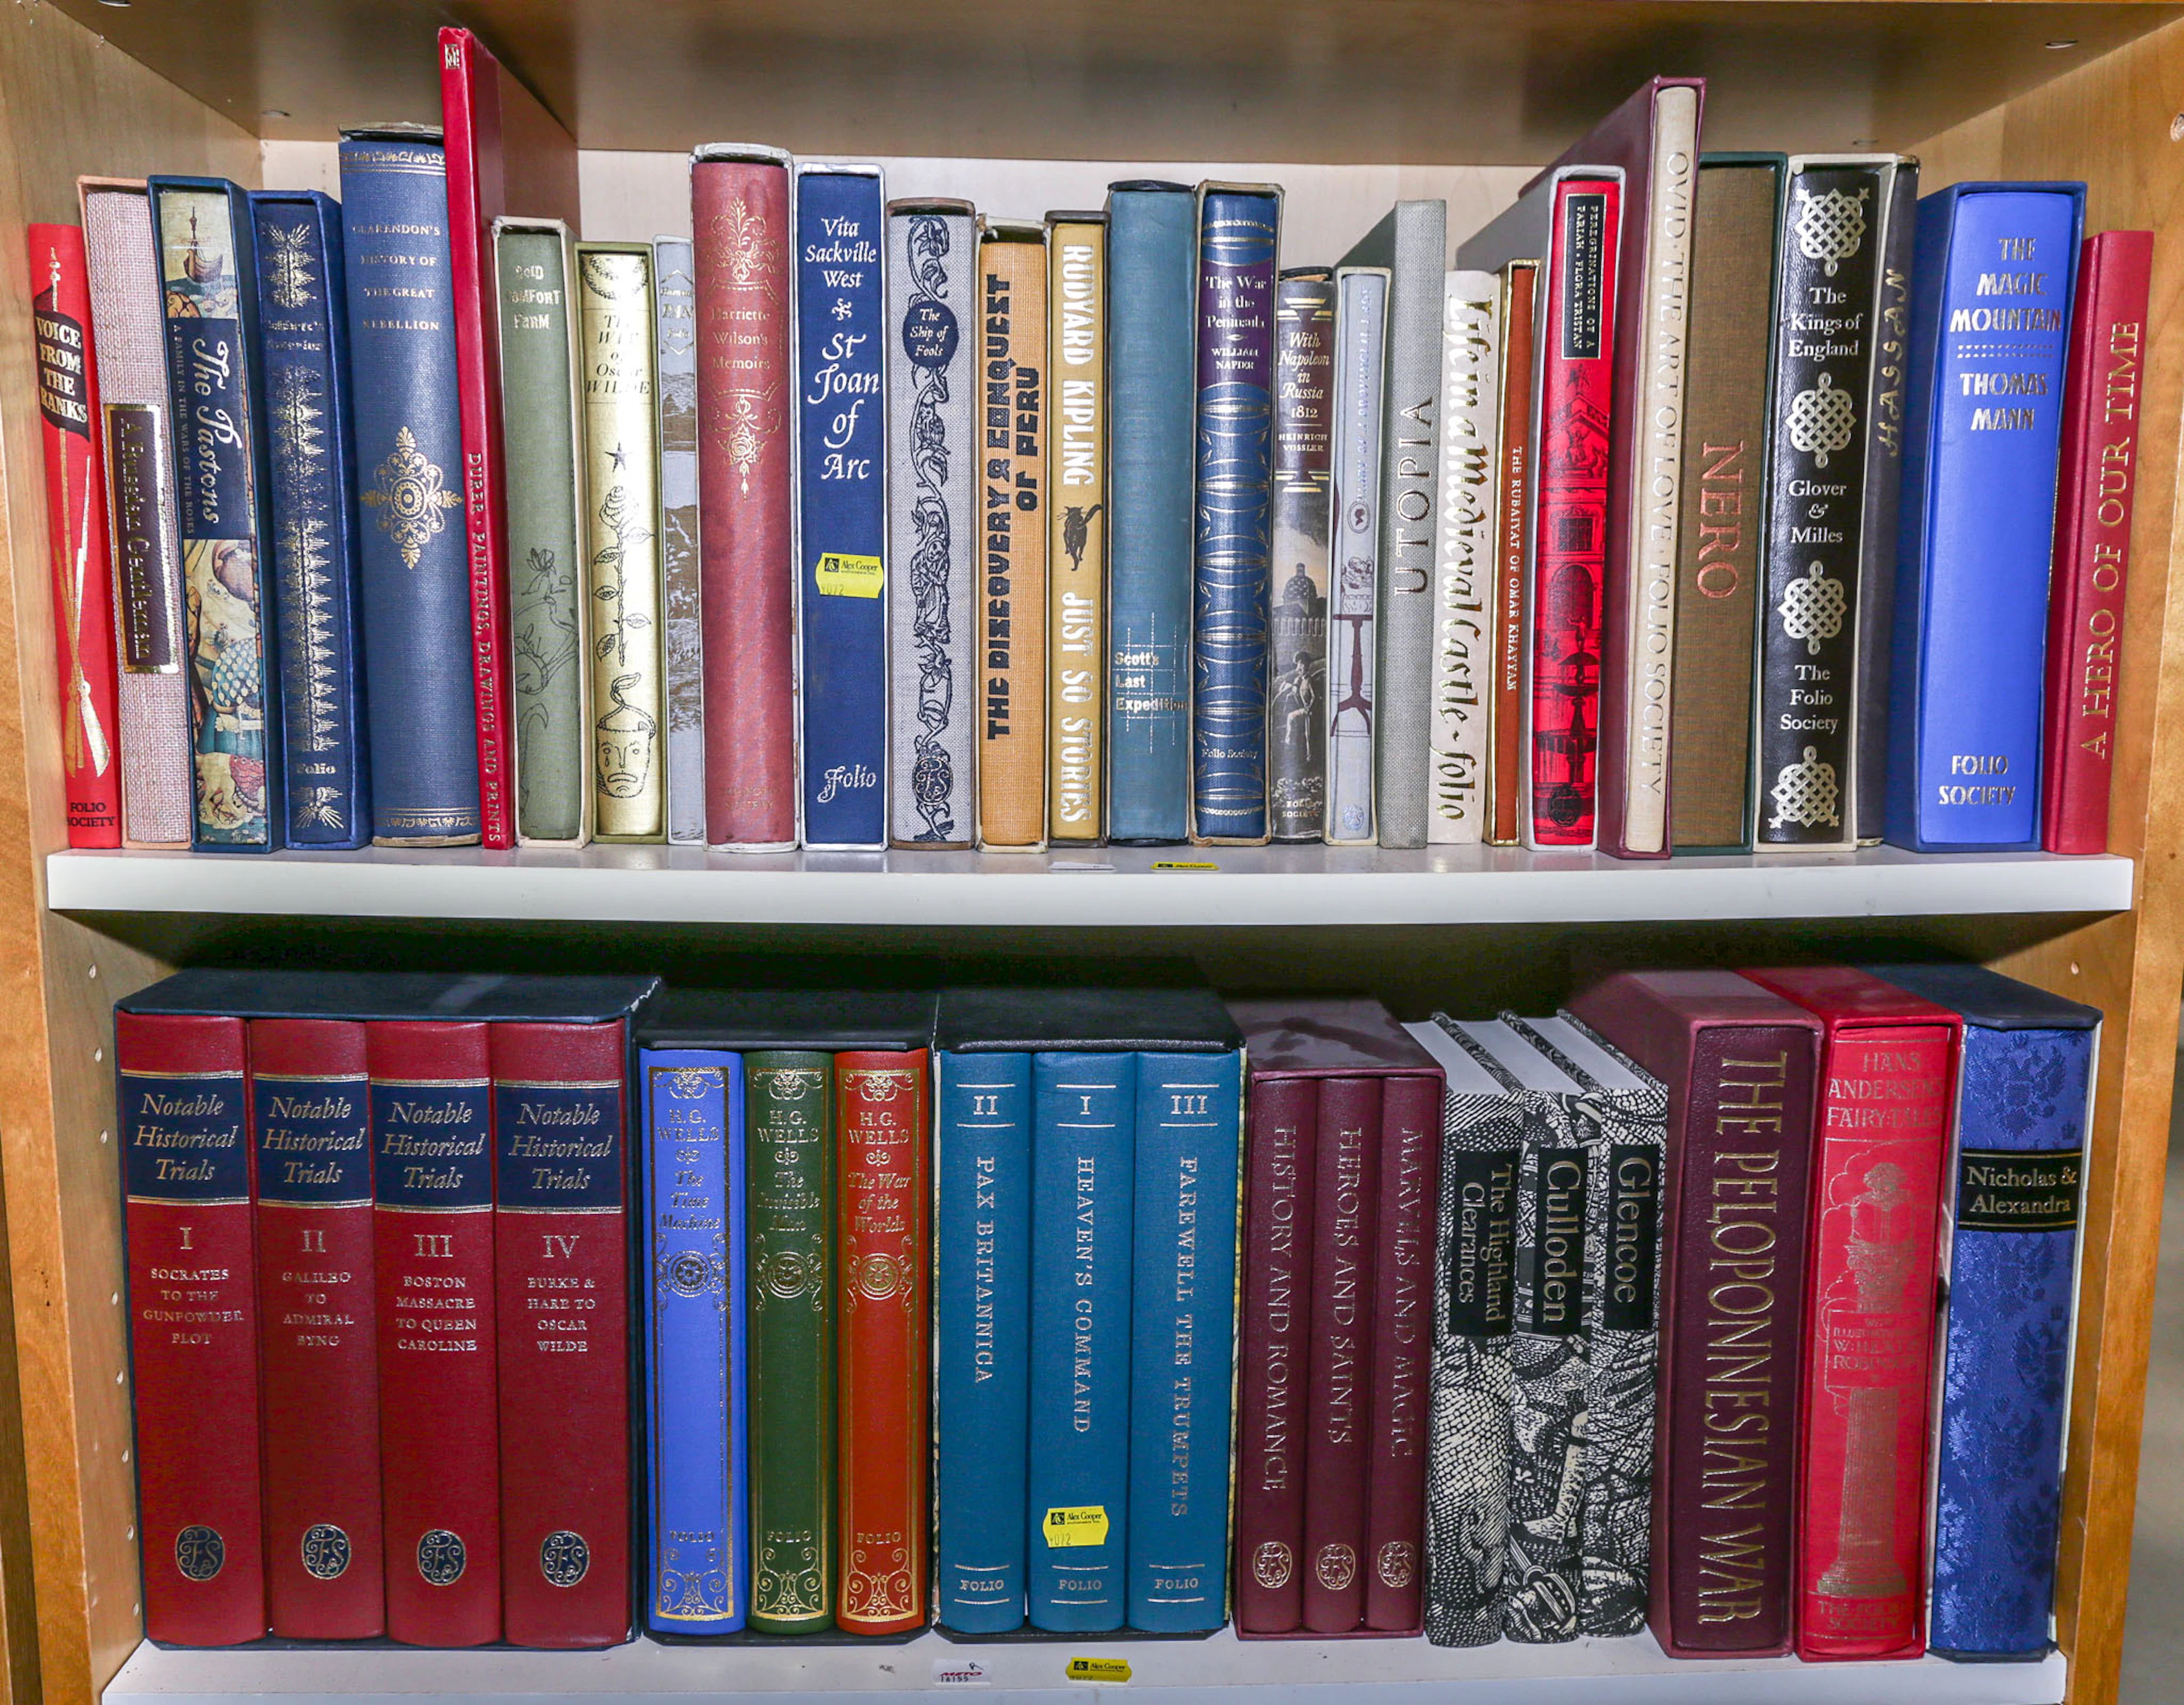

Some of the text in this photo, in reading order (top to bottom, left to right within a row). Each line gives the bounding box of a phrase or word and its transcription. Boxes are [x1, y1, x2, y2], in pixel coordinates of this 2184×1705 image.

[821, 216, 860, 237] Vita
[805, 241, 877, 263] Sackville
[1999, 238, 2036, 261] THE
[822, 270, 863, 288] West
[1575, 260, 1584, 298] FLORA
[1976, 273, 2048, 296] MAGIC
[1809, 287, 1847, 304] The
[920, 308, 940, 321] The
[1790, 313, 1864, 335] Kings of
[1950, 308, 2062, 332] MOUNTAIN
[35, 316, 81, 349] VOICE
[910, 326, 949, 342] Ship of
[1573, 303, 1583, 349] TRISTAN
[1586, 319, 1595, 333] OF
[822, 333, 867, 361] St
[915, 343, 944, 357] Fools
[1289, 332, 1321, 348] With
[39, 343, 81, 374] FROM
[1278, 350, 1330, 373] Napoleon
[1788, 341, 1859, 361] England
[1062, 245, 1095, 487] RUDYARD KIPLING
[1297, 369, 1311, 383] in
[43, 368, 75, 395] THE
[808, 363, 880, 404] Joan
[1279, 383, 1324, 400] Russia
[1960, 373, 2048, 395] THOMAS
[40, 386, 88, 423] RANKS
[1290, 405, 1319, 418] 1812
[824, 399, 864, 449] of
[1970, 408, 2034, 431] MANN
[191, 337, 242, 525] The Pastons
[1016, 367, 1040, 511] OF PERU
[1279, 433, 1328, 441] HEINRICH
[821, 455, 870, 481] Arc
[1641, 151, 1689, 794] OVID THE ART OF LOVE FOLIO SOCIETY
[1395, 397, 1433, 596] UTOPIA
[1788, 480, 1847, 497] Glover
[986, 274, 1017, 740] THE DISCOVERY & CONQUEST
[1809, 505, 1828, 520] &
[1697, 440, 1744, 600] NERO
[1790, 527, 1843, 544] Milles
[2080, 321, 2140, 759] A HERO OF OUR TIME
[842, 560, 879, 571] Alex Cooper
[1507, 445, 1523, 691] THE RUBAIYAT OF OMAR KHAYYAM
[1115, 651, 1160, 667] Scott's
[1115, 674, 1146, 689] Last
[1795, 664, 1830, 681] The
[1060, 592, 1094, 823] JUST SO STORIES
[1115, 696, 1187, 713] Expedition
[1789, 690, 1833, 706] Folio
[1780, 715, 1839, 735] Society
[1951, 755, 2008, 775] FOLIO
[817, 763, 876, 803] Folio
[1938, 786, 2016, 805] SOCIETY
[140, 1093, 223, 1116] Notable
[516, 1103, 600, 1125] Notable
[973, 1095, 998, 1115] II
[1080, 1095, 1091, 1115] I
[1171, 1095, 1208, 1114] III
[860, 1112, 897, 1126] H.G.
[134, 1125, 238, 1149] Historical
[657, 1126, 719, 1142] WELLS
[849, 1129, 909, 1144] WELLS
[508, 1135, 613, 1157] Historical
[156, 1158, 216, 1180] Trials
[531, 1167, 591, 1189] Trials
[675, 1170, 704, 1187] The
[1966, 1166, 2077, 1187] Nicholas &
[1970, 1194, 2071, 1215] Alexandra
[180, 1227, 193, 1249] I
[1614, 1157, 1652, 1303] Glencoe
[302, 1230, 326, 1252] II
[413, 1234, 453, 1257] III
[542, 1235, 580, 1258] IV
[1459, 1182, 1486, 1303] Clearances
[1480, 1163, 1512, 1322] The Highland
[1542, 1160, 1581, 1323] Culloden
[151, 1269, 229, 1281] SOCRATES
[283, 1271, 351, 1283] GALILEO
[975, 1156, 995, 1383] PAX BRITANNICA
[403, 1276, 466, 1288] BOSTON
[528, 1277, 595, 1288] BURKE &
[1328, 1127, 1362, 1444] HEROES AND SAINTS
[160, 1290, 181, 1301] TO
[305, 1294, 326, 1303] TO
[396, 1297, 475, 1309] MASSACRE
[528, 1298, 595, 1310] HARE TO
[1074, 1156, 1095, 1432] HEAVEN'S COMMAND
[143, 1310, 245, 1322] GUNPOWDER
[284, 1314, 354, 1325] ADMIRAL
[1263, 1126, 1296, 1492] HISTORY AND ROMANCE
[396, 1318, 477, 1332] TO QUEEN
[537, 1319, 587, 1330] OSCAR
[172, 1334, 212, 1345] PLOT
[398, 1339, 477, 1352] CAROLINE
[537, 1340, 588, 1352] WILDE
[1171, 1156, 1198, 1516] FAREWELL THE TRUMPETS
[1698, 1051, 1788, 1625] THE PELOPONNESIAN WAR
[1081, 1512, 1102, 1522] Cooper
[857, 1532, 901, 1544] FOLIO
[960, 1579, 1004, 1591] FOLIO
[1058, 1579, 1102, 1591] FOLIO
[1155, 1578, 1199, 1590] FOLIO
